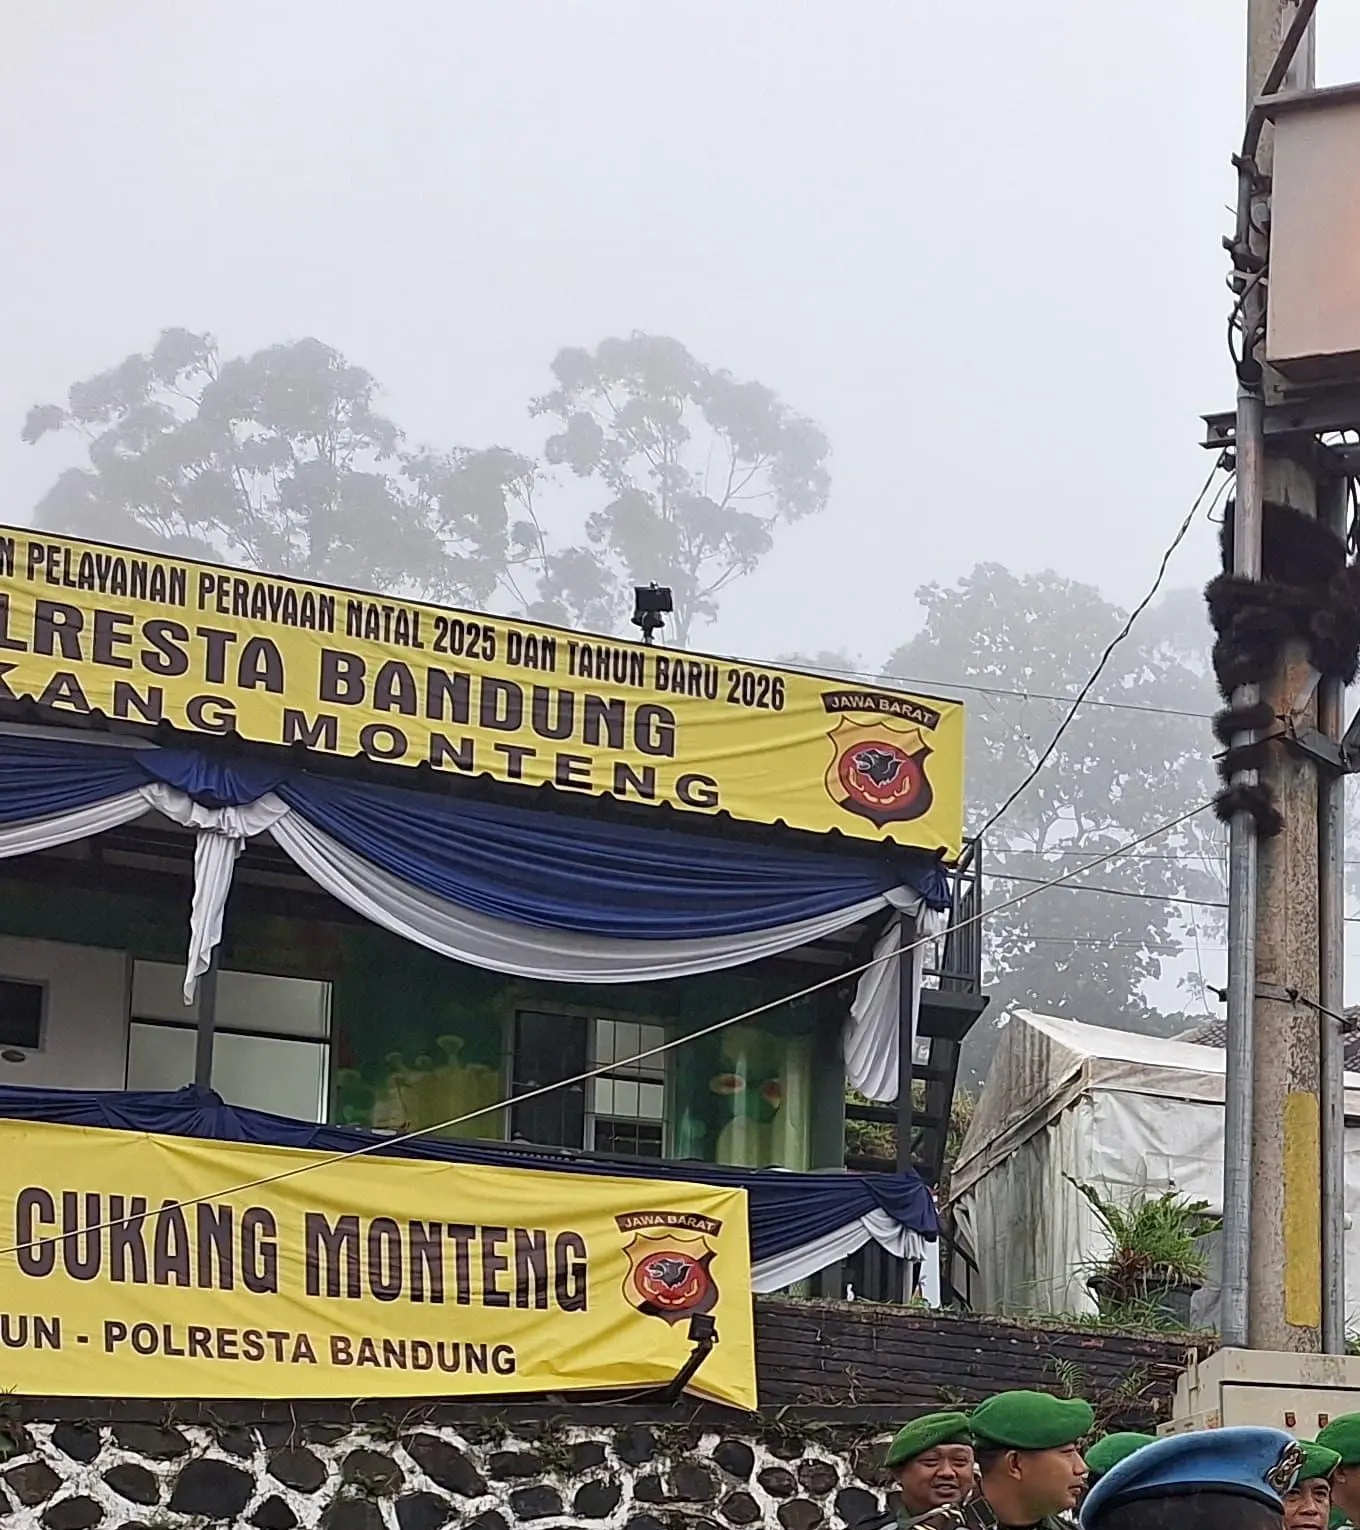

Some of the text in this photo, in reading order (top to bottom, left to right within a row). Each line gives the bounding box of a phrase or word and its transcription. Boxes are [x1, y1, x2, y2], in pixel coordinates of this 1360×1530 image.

[27, 541, 187, 606] PELAYANAN
[198, 572, 335, 633] PERAYAAN
[346, 599, 424, 649] NATAL
[433, 616, 496, 662] 2025
[506, 629, 556, 673] DAN
[567, 640, 645, 687] TAHUN
[655, 654, 719, 701] BARU
[727, 670, 785, 711] 2026
[320, 648, 676, 758] BANDUNG
[830, 694, 934, 725] JAWA BARAT
[283, 708, 720, 808] MONTENG
[16, 1187, 588, 1312] CUKANG MONTENG
[624, 1216, 716, 1231] JAWA BARAT
[0, 1314, 516, 1376] UN - POLRESTA BANDUNG
